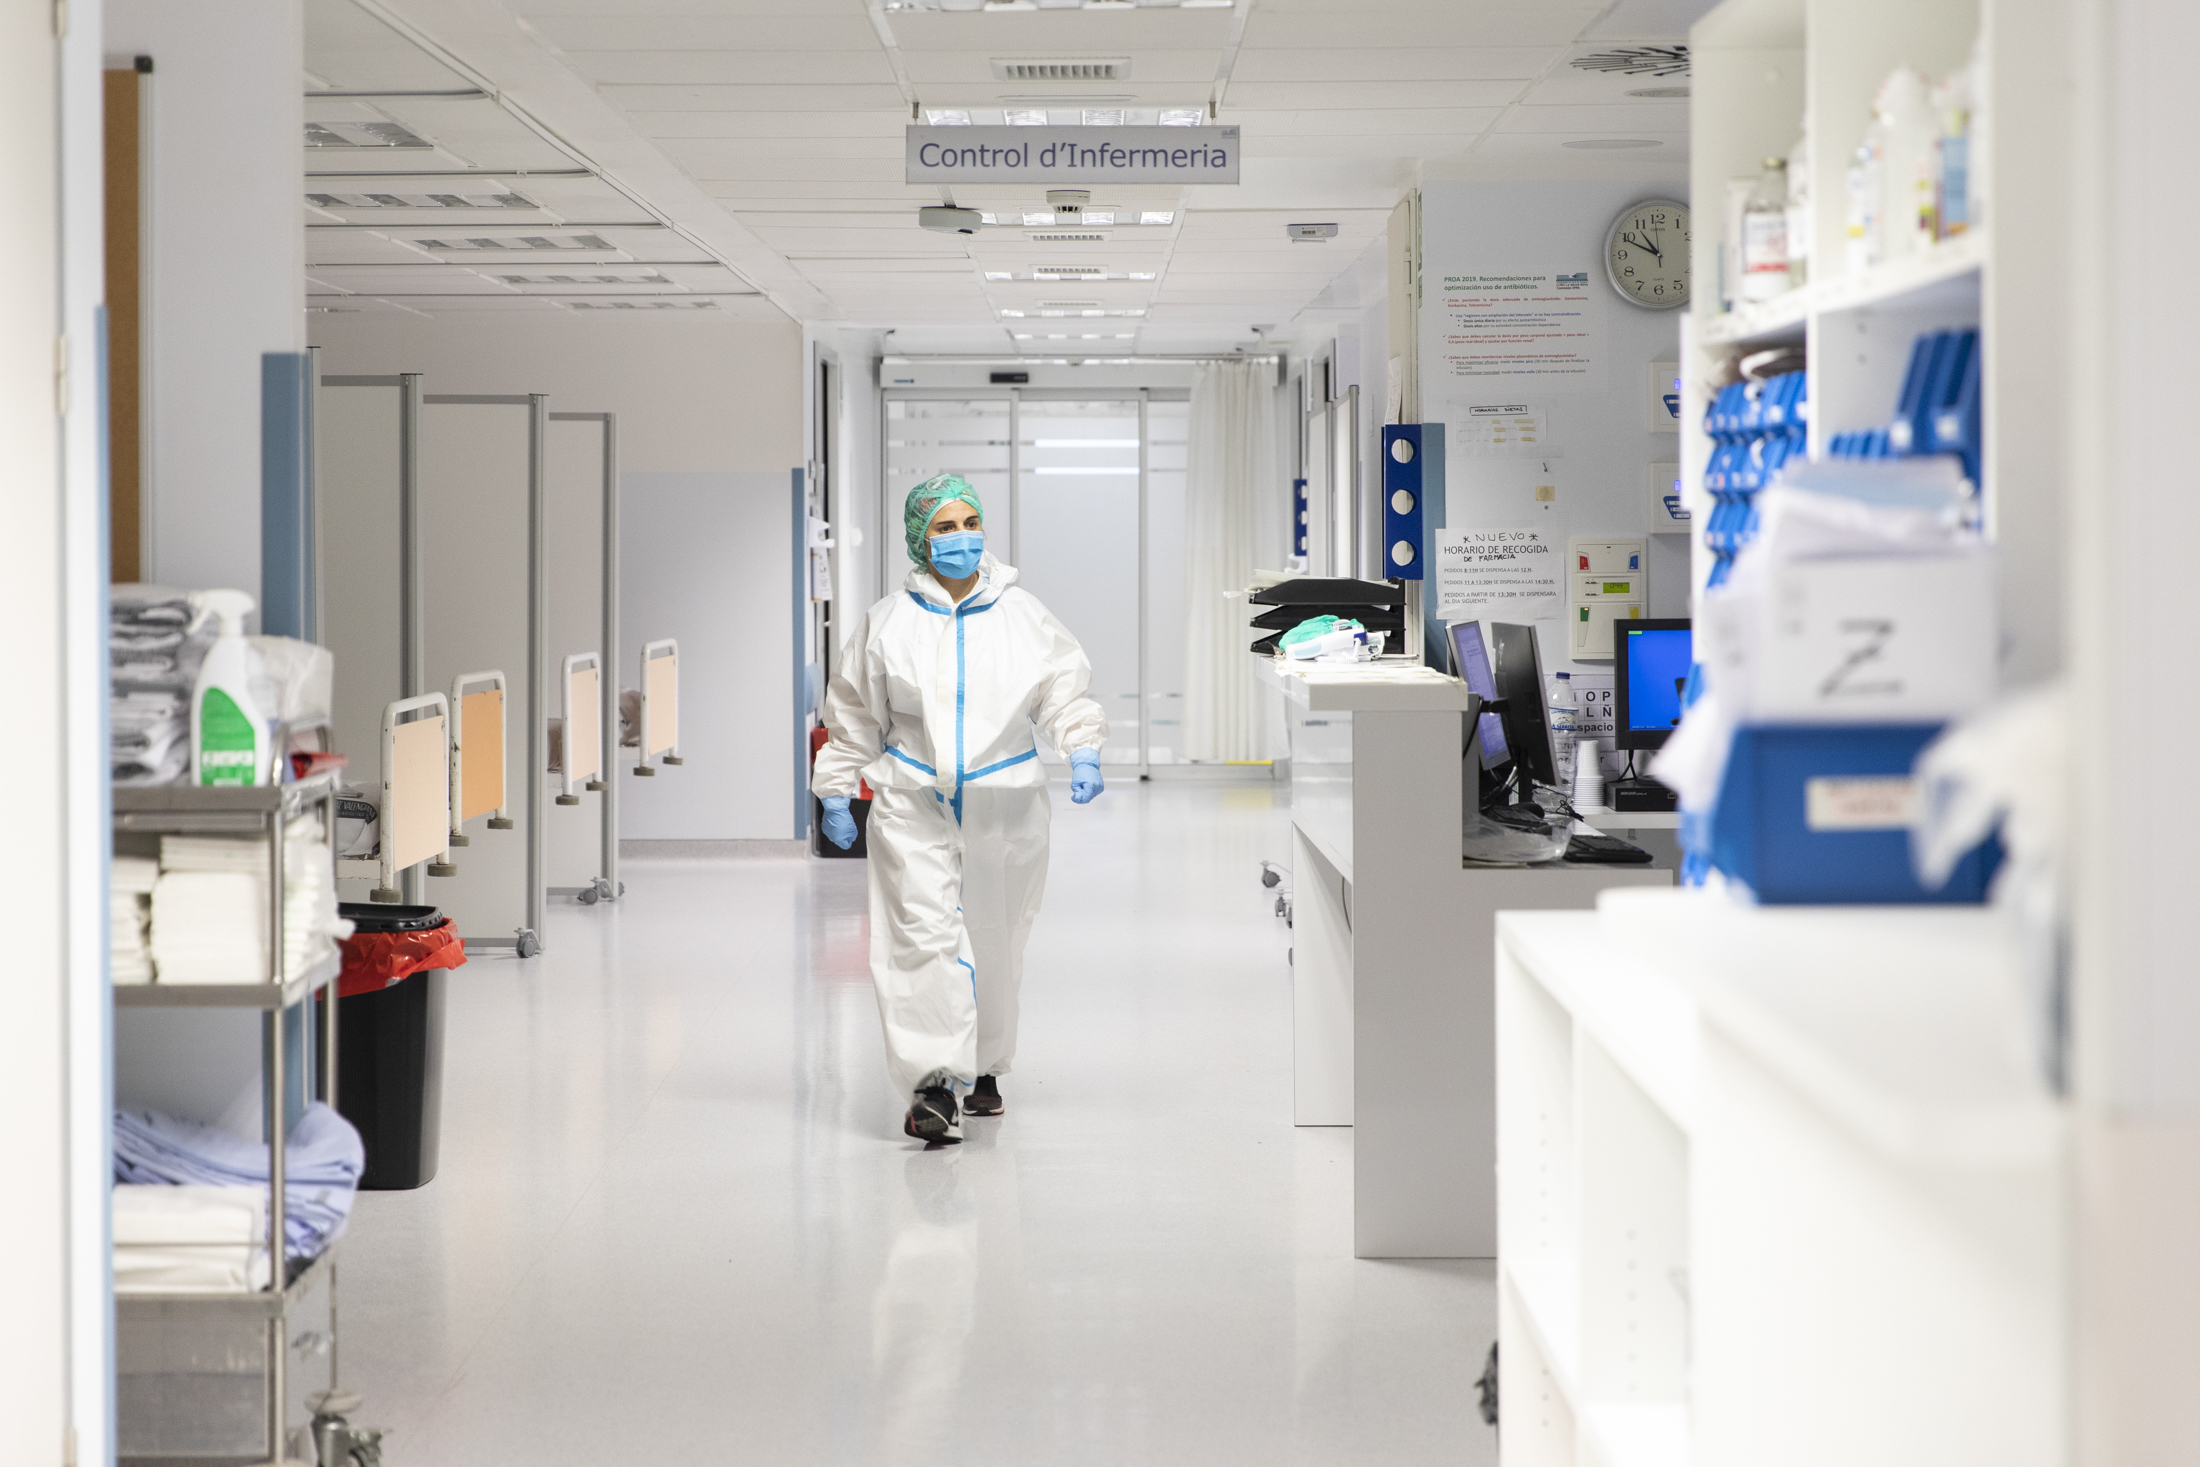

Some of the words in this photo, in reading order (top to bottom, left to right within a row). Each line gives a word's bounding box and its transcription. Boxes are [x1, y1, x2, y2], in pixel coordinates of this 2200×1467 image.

[920, 142, 1028, 168] Control
[1040, 142, 1226, 168] d'Infermeria
[1635, 219, 1646, 229] 11
[1675, 219, 1680, 229] 1
[1651, 214, 1665, 224] 12
[1623, 232, 1635, 242] 10
[1618, 250, 1627, 260] 9
[1624, 266, 1634, 277] 8
[1636, 280, 1645, 291] 7
[1673, 280, 1683, 290] 5
[1654, 285, 1664, 295] 6
[1444, 546, 1485, 554] HORARIO
[1488, 546, 1499, 554] DE
[1503, 545, 1548, 553] RECOGIDA
[1586, 691, 1596, 701] O
[1602, 692, 1611, 701] P
[1587, 707, 1594, 717] L
[1603, 704, 1611, 717] Ñ
